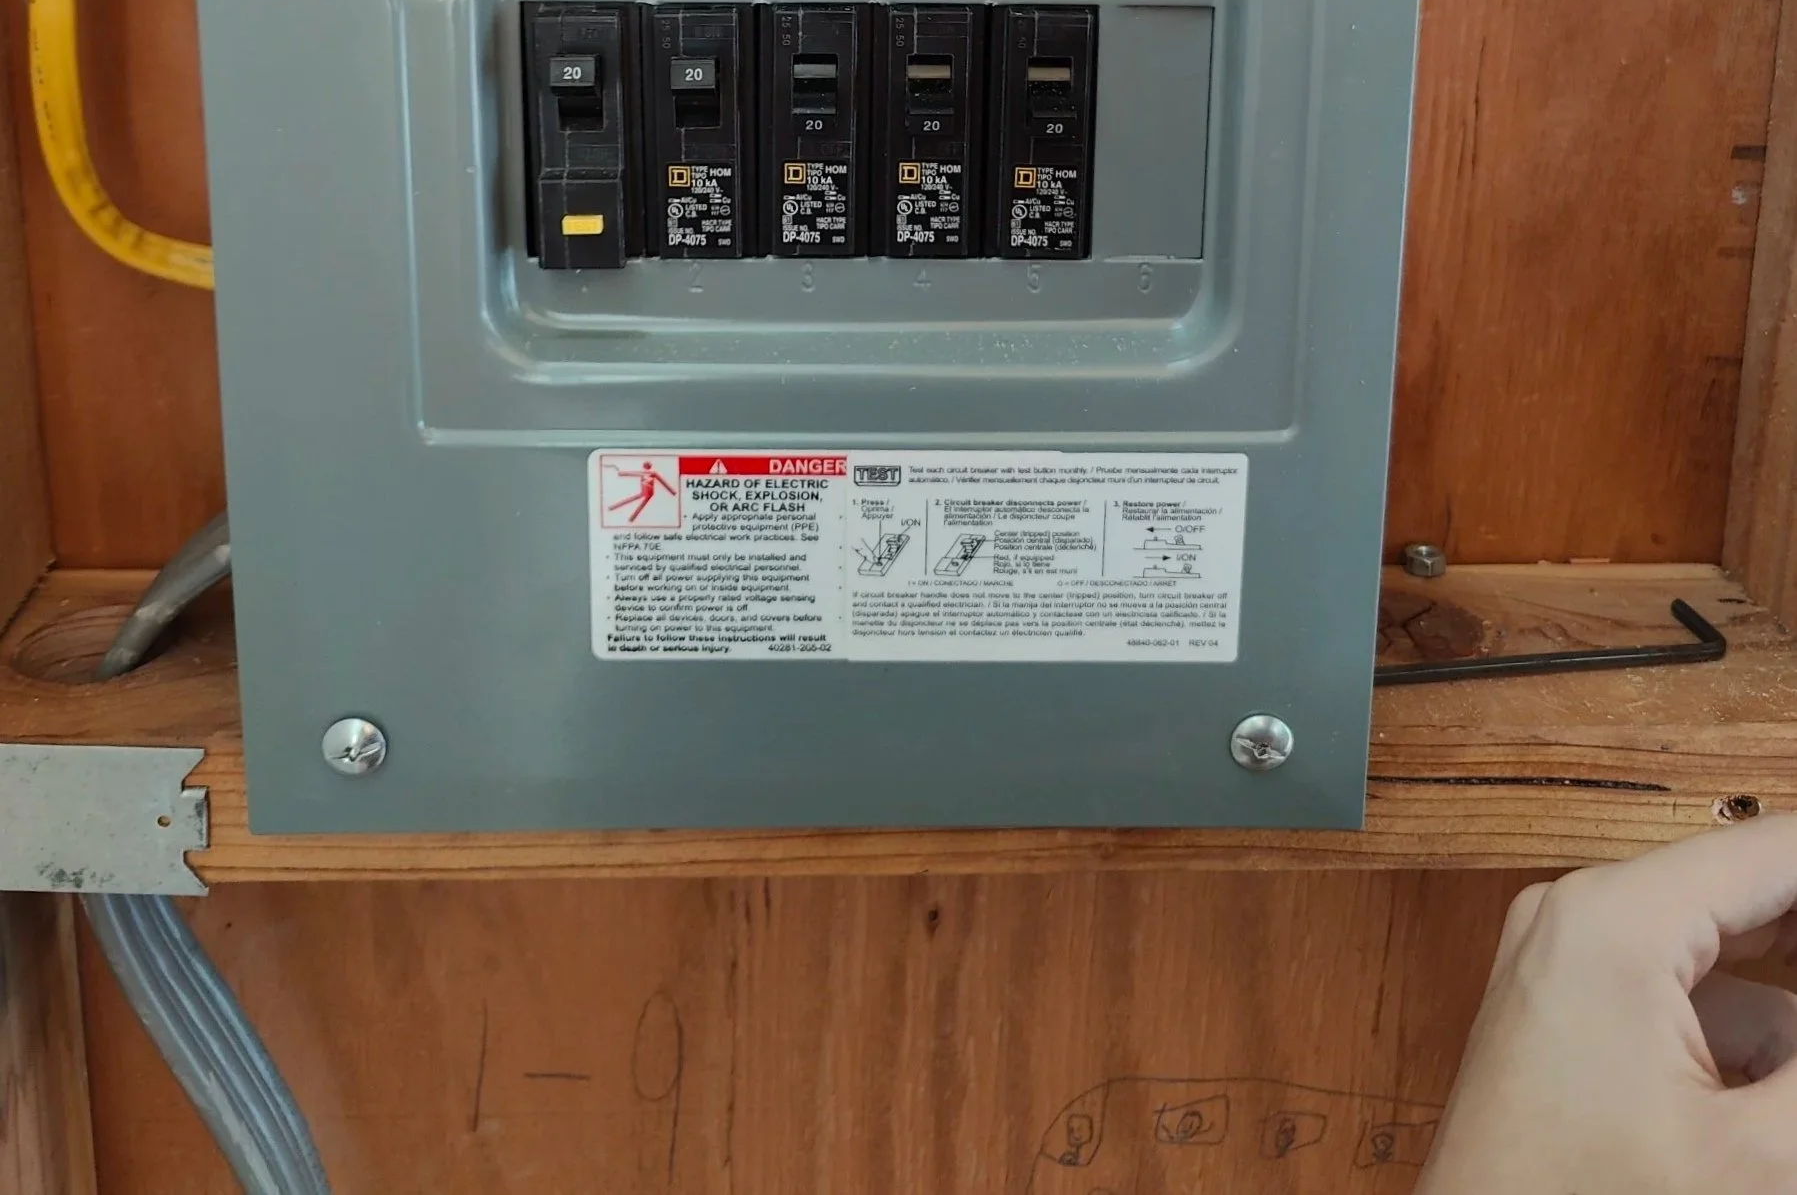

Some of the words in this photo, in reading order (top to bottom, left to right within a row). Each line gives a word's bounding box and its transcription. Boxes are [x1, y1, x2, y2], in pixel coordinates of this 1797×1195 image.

[562, 66, 582, 80] 20
[685, 67, 703, 81] 20
[805, 119, 823, 131] 20
[923, 120, 941, 131] 20
[1045, 123, 1064, 134] 20
[709, 167, 732, 177] HOM
[824, 164, 848, 175] HOM
[939, 164, 962, 174] HOM
[1055, 169, 1077, 179] HOM
[668, 233, 706, 246] DP-4075
[782, 231, 820, 243] DP-4075
[897, 231, 934, 242] DP-4075
[1011, 235, 1048, 246] DP-4075
[769, 459, 847, 474] DANGER
[856, 467, 899, 482] TEST
[686, 479, 740, 489] HAZARD
[743, 479, 760, 489] OF
[764, 479, 828, 489] ELECTRIC
[709, 503, 728, 512] OR
[731, 503, 758, 512] ARC
[763, 503, 805, 512] FLASH
